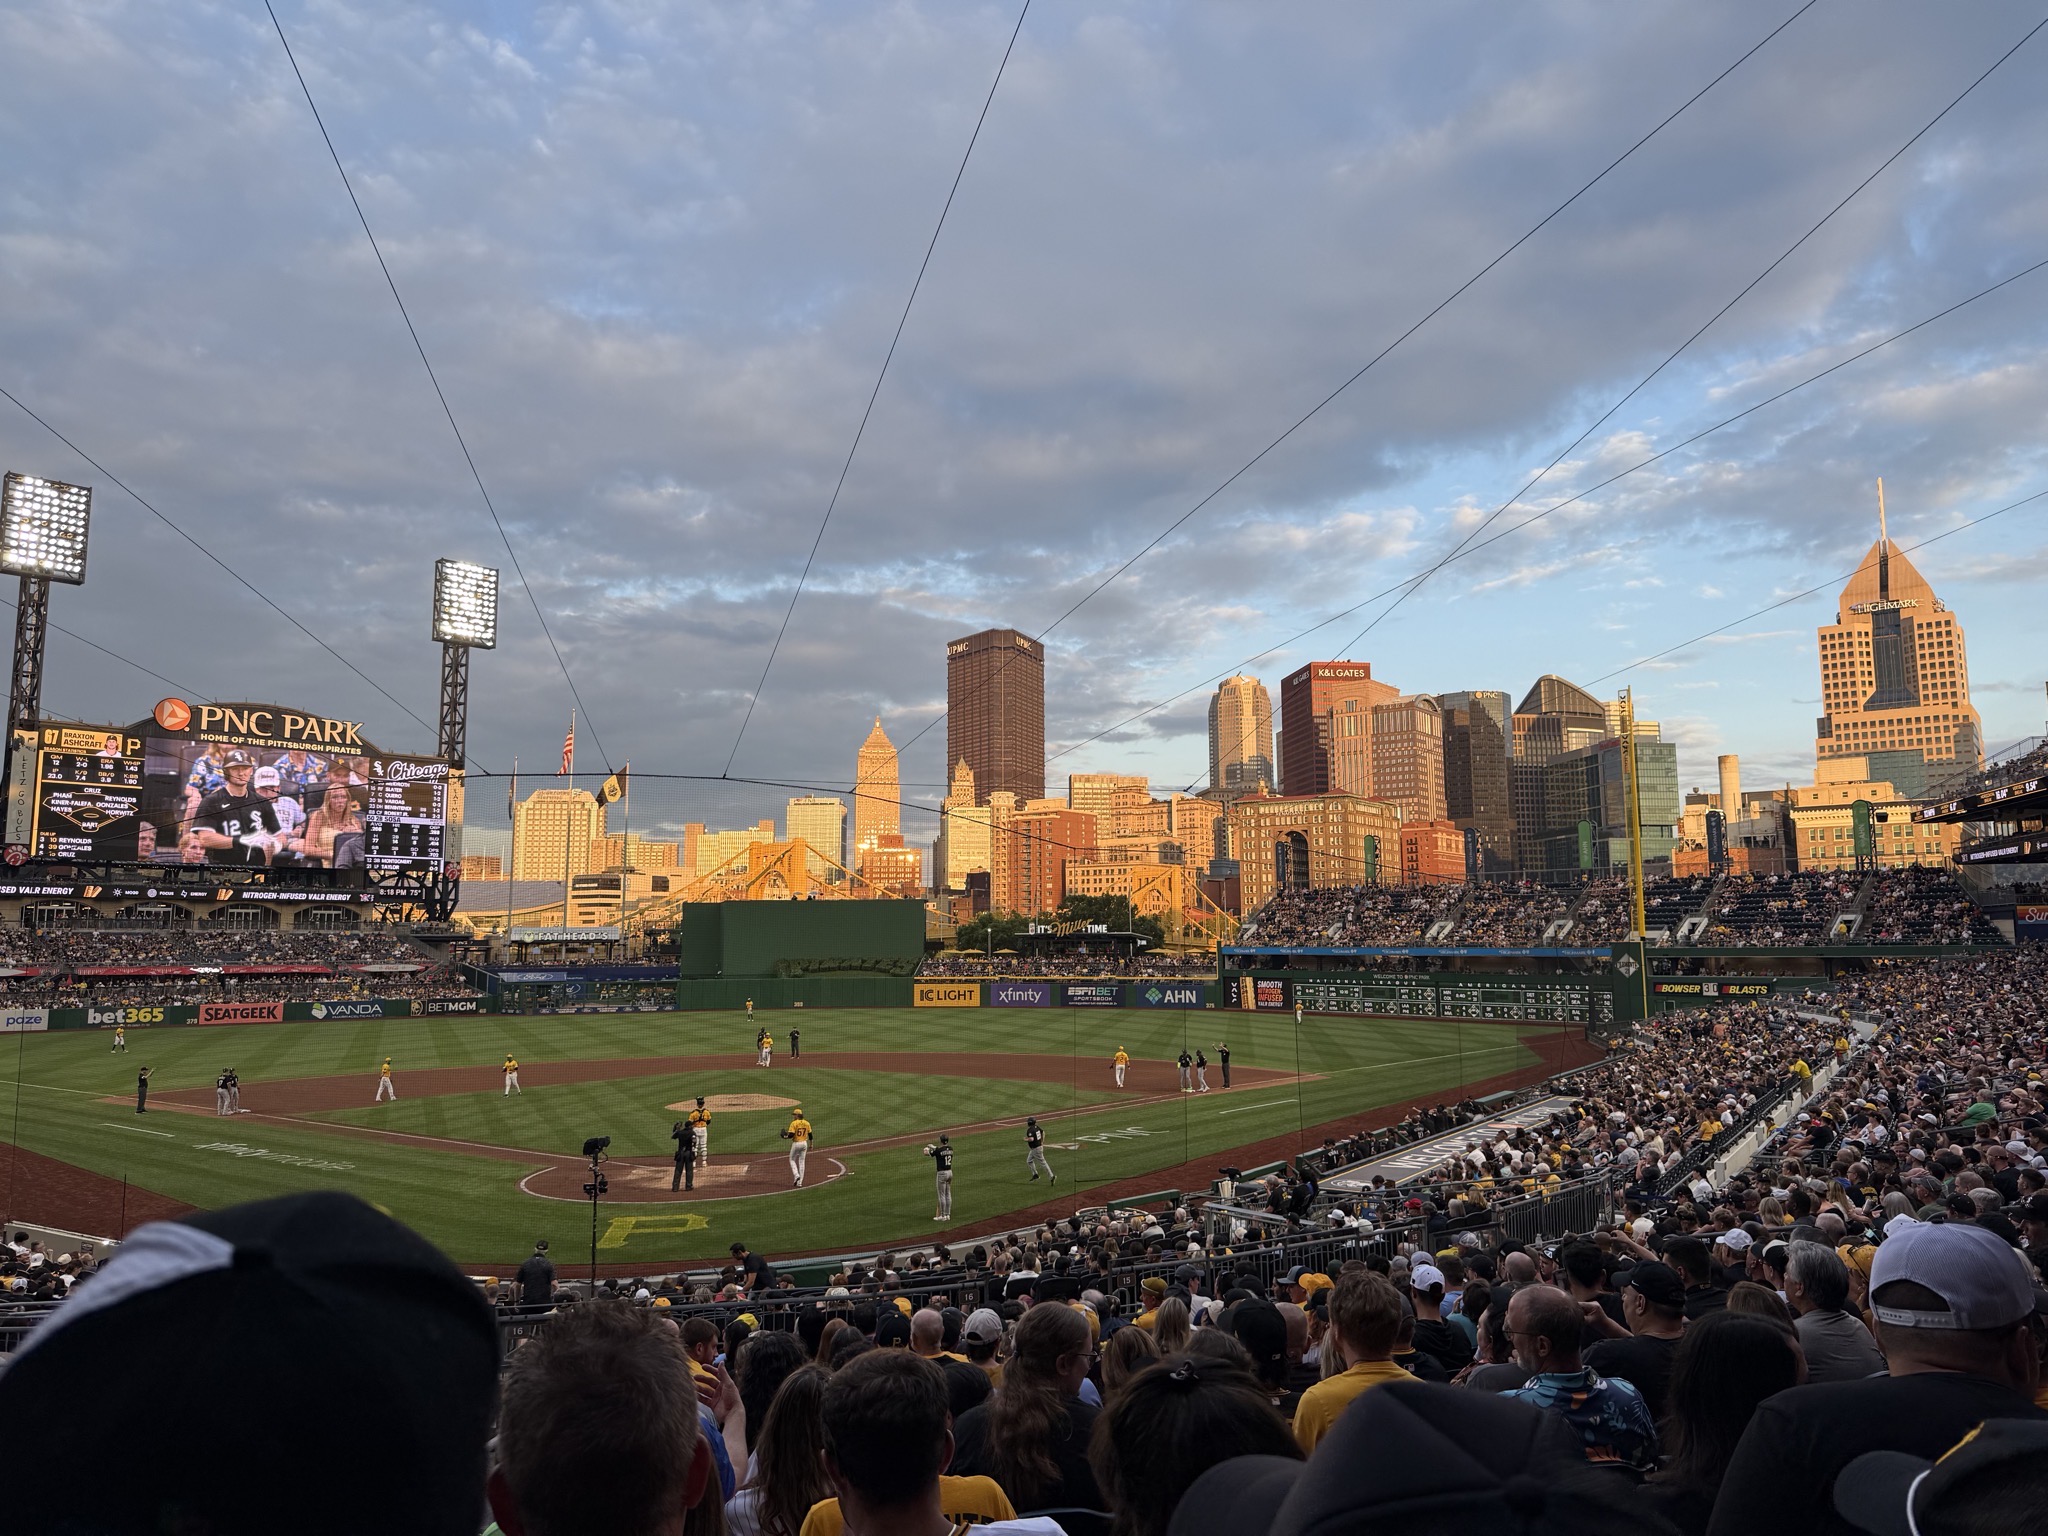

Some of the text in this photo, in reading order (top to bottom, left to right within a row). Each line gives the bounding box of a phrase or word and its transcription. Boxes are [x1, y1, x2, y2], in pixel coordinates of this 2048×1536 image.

[1858, 599, 1918, 613] HIGHMARK
[947, 642, 969, 655] UPMC
[1336, 669, 1364, 677] GATES
[198, 705, 364, 746] PNC PARK
[44, 730, 59, 744] 67
[64, 732, 94, 740] BRAXTON
[64, 739, 102, 748] ASHCRAFT
[201, 734, 229, 742] HOME
[247, 737, 265, 746] THE
[268, 739, 323, 751] PITTSBURGH
[326, 745, 361, 755] PIRATES
[387, 761, 448, 781] Chicago
[16, 755, 27, 841] LETZ GO BUCS
[222, 820, 242, 836] 12
[19, 886, 40, 895] VALR
[42, 887, 74, 895] ENERGY
[243, 892, 306, 900] NITROGEN-INFUSED
[1038, 925, 1052, 933] IT'S
[1051, 919, 1094, 937] Miller
[1087, 925, 1107, 933] TIME
[538, 932, 608, 940] FAT HEAD'S
[937, 990, 974, 1000] LIGHT
[1729, 986, 1767, 994] BLASTS
[999, 988, 1042, 1003] xfinity
[1164, 990, 1196, 1003] AHN
[328, 1005, 382, 1014] VANDA
[429, 1002, 476, 1012] BETMGM
[88, 1008, 164, 1024] bet365
[205, 1005, 279, 1021] SEATGEEK
[6, 1016, 42, 1027] paze
[797, 1128, 806, 1136] 67
[945, 1156, 951, 1166] 12
[597, 1213, 709, 1248] P
[513, 1327, 523, 1335] 16
